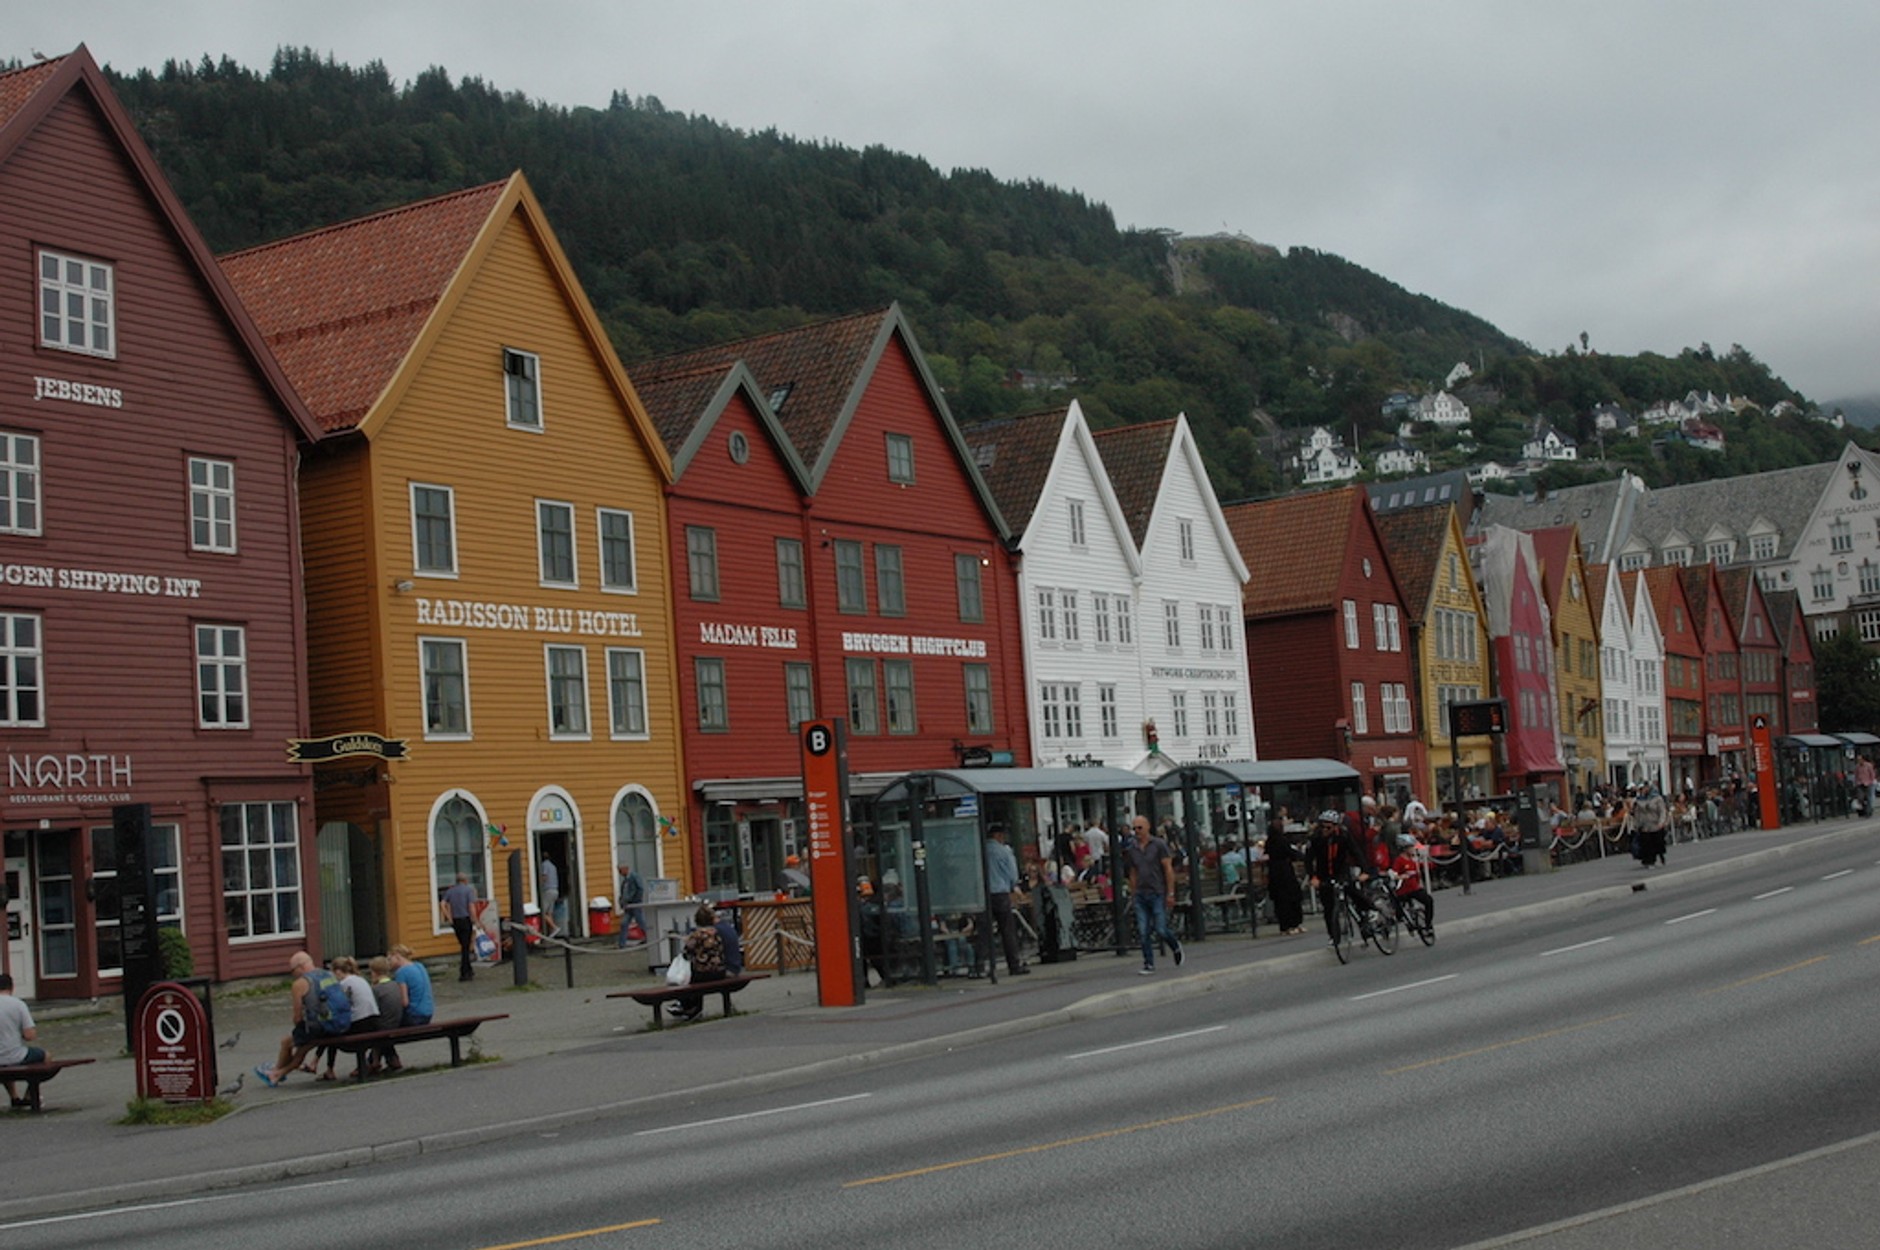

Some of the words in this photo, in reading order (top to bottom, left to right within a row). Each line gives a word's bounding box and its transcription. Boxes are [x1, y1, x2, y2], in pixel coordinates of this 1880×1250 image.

[33, 376, 122, 408] JEBSENS
[58, 568, 160, 595] SHIPPING
[164, 577, 201, 598] INT
[416, 598, 529, 630] RADISSON
[534, 607, 573, 633] BLU
[578, 611, 642, 637] HOTEL
[700, 622, 758, 647] MADAM
[761, 626, 798, 649] FELLE
[842, 632, 909, 653] BRYGGEN
[911, 636, 987, 657] NIGHTCLUB
[1755, 717, 1765, 729] A
[811, 730, 826, 751] B
[8, 754, 132, 788] NORTH
[9, 794, 66, 803] RESTAURANT
[75, 794, 108, 803] SOCIAL
[109, 793, 131, 802] CLUB
